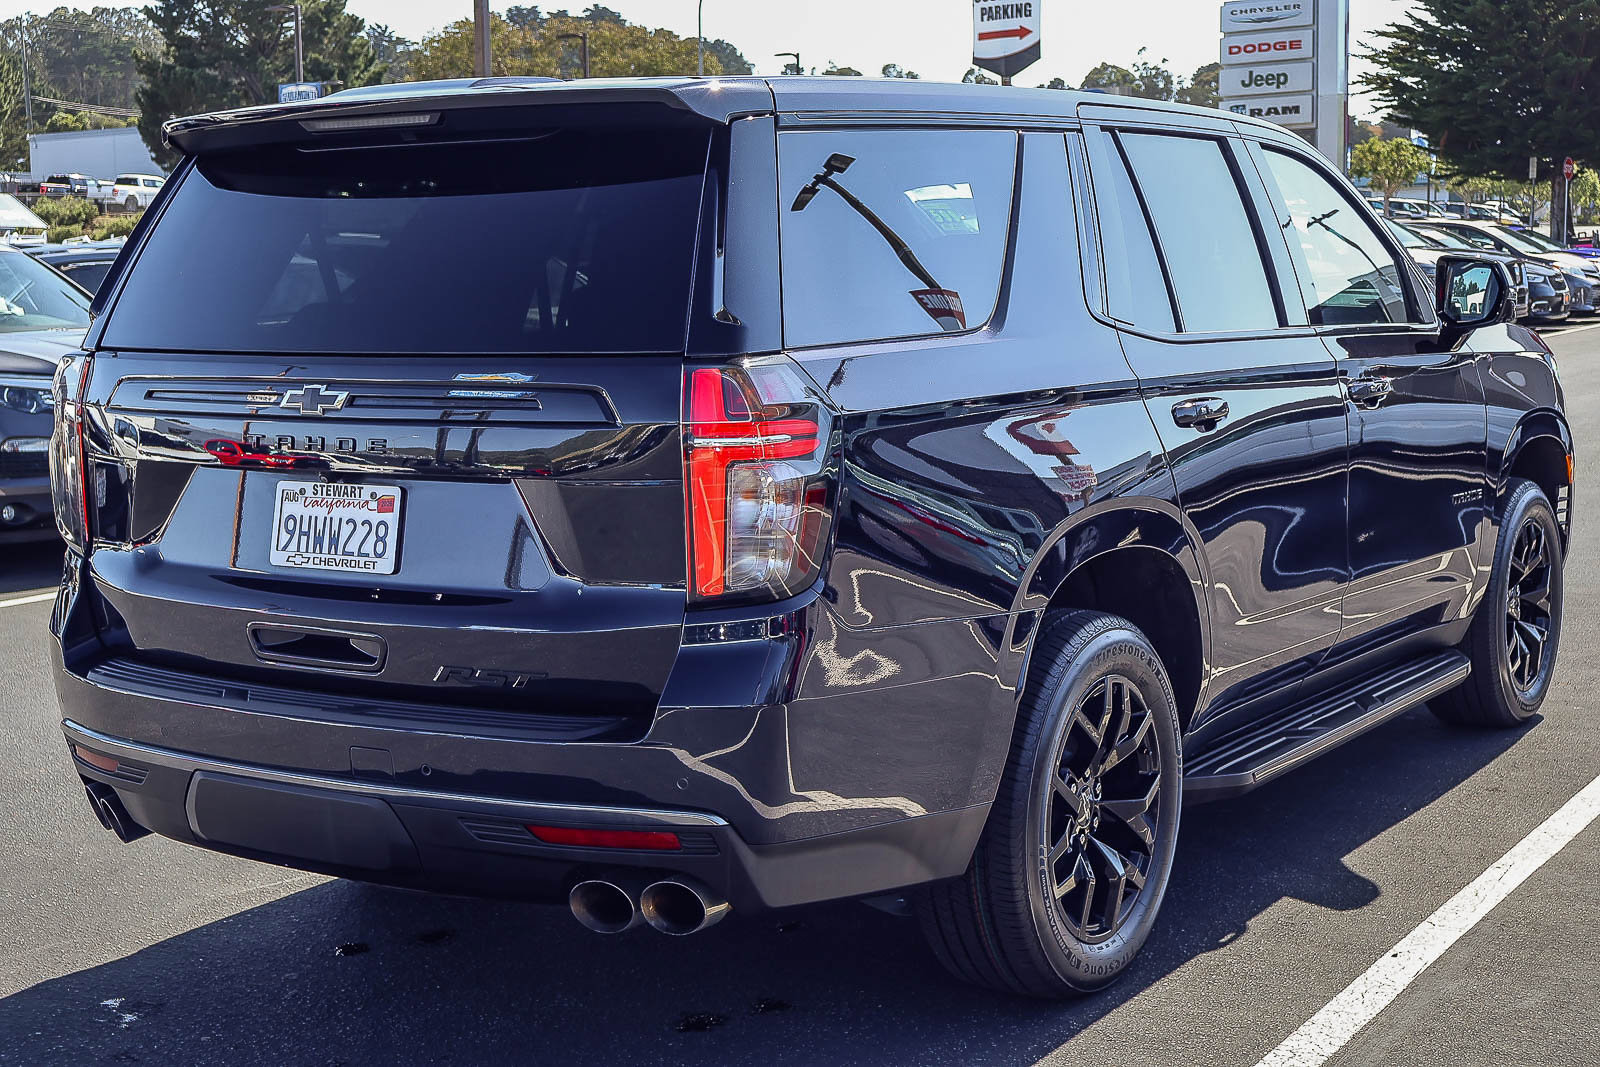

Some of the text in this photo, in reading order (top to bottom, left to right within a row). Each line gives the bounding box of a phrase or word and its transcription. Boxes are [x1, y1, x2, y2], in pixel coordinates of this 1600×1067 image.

[980, 2, 1033, 22] PARKING
[1230, 4, 1302, 16] CHRYSLER
[1228, 40, 1303, 55] DODGE
[1241, 70, 1288, 89] Jeep
[1249, 105, 1300, 117] RAM
[246, 433, 389, 454] TAHOE
[284, 491, 300, 503] AUG
[312, 484, 364, 499] STEWART
[303, 497, 377, 515] California
[281, 513, 390, 559] 9HWW228
[312, 556, 378, 570] CHEVROLET
[1095, 642, 1146, 667] Firestone
[433, 665, 549, 689] RST
